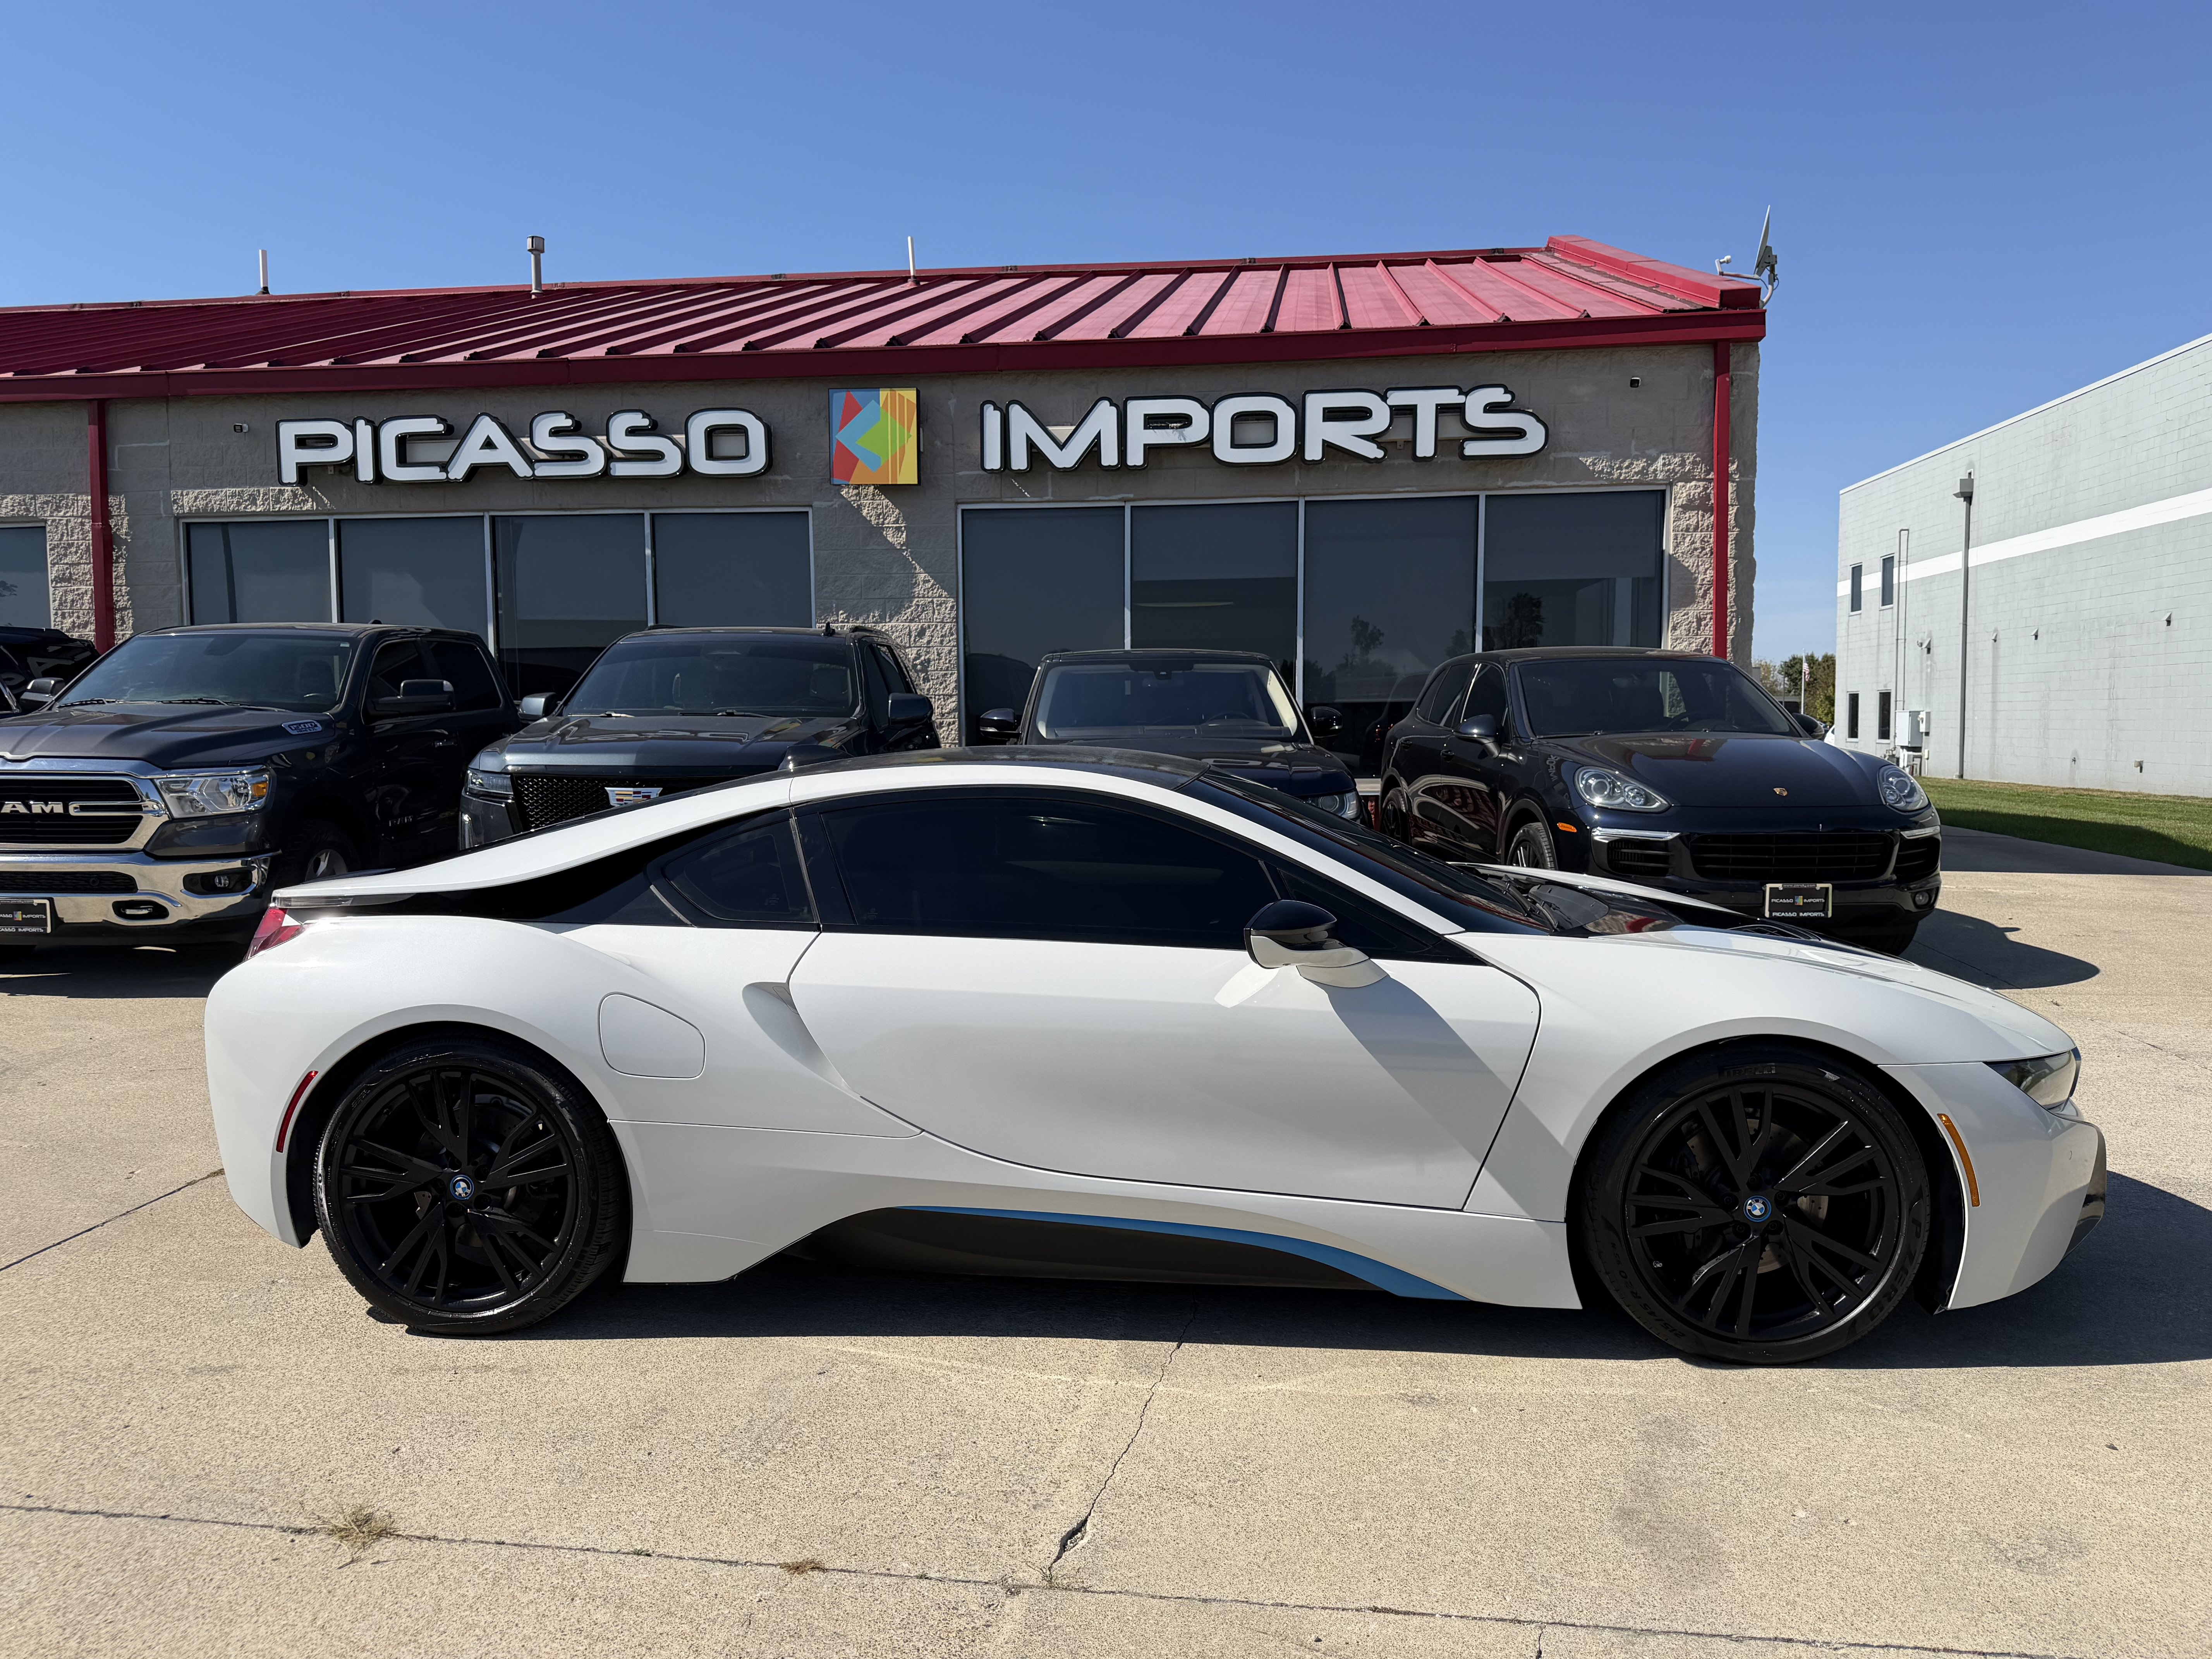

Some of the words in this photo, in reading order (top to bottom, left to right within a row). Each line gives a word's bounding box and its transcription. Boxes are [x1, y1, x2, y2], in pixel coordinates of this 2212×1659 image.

[276, 407, 773, 486] PICASSO
[979, 384, 1548, 474] IMPORTS
[1912, 1217, 1922, 1239] P
[1619, 1270, 1641, 1300] R20
[1867, 1244, 1917, 1322] ZERO
[1639, 1303, 1686, 1338] 215/45
